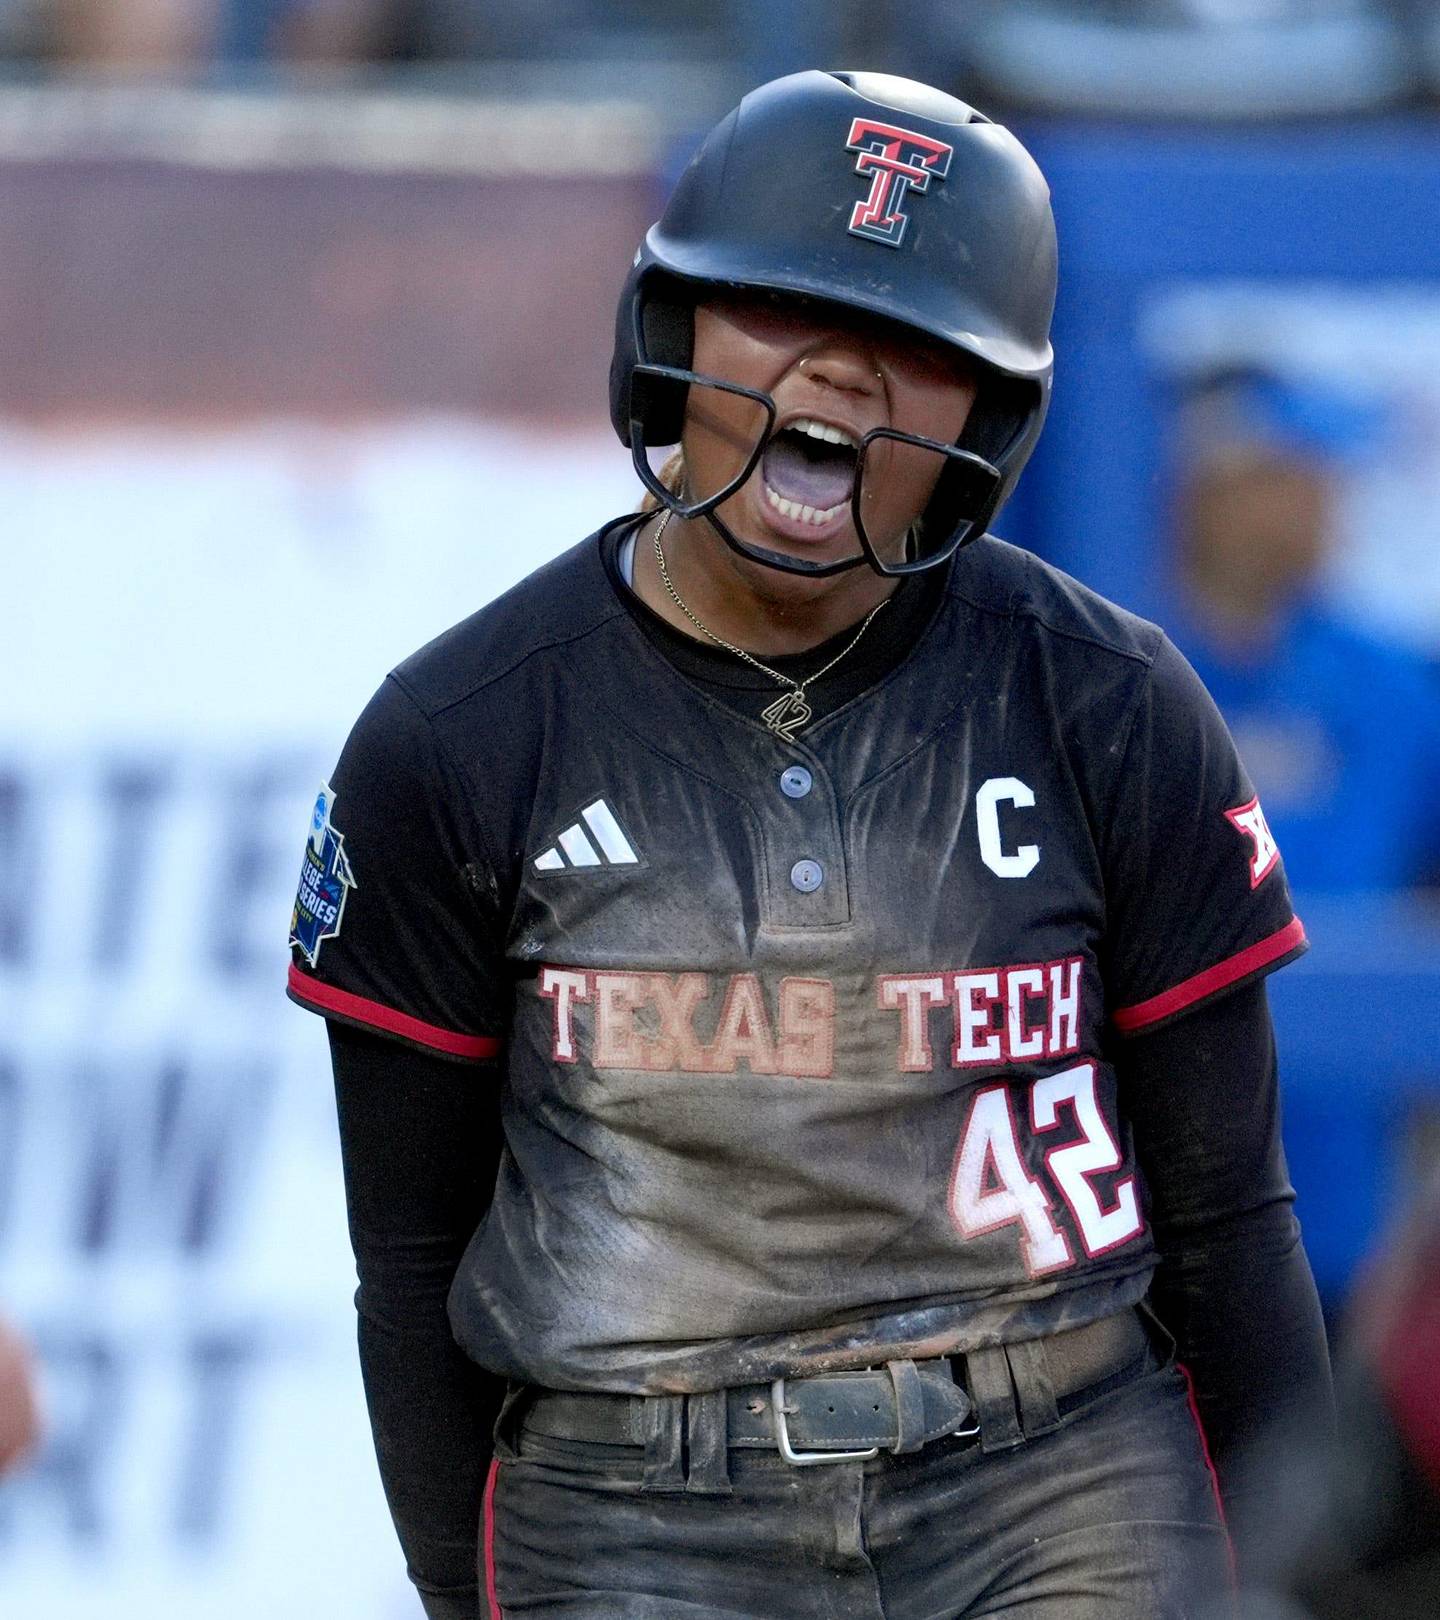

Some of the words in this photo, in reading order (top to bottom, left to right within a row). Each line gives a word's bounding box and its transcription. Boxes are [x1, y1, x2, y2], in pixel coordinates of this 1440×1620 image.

[761, 692, 812, 743] 42
[976, 777, 1040, 878] C
[537, 964, 836, 1079] TEXAS
[876, 954, 1086, 1072] TECH
[948, 1056, 1145, 1280] 42
